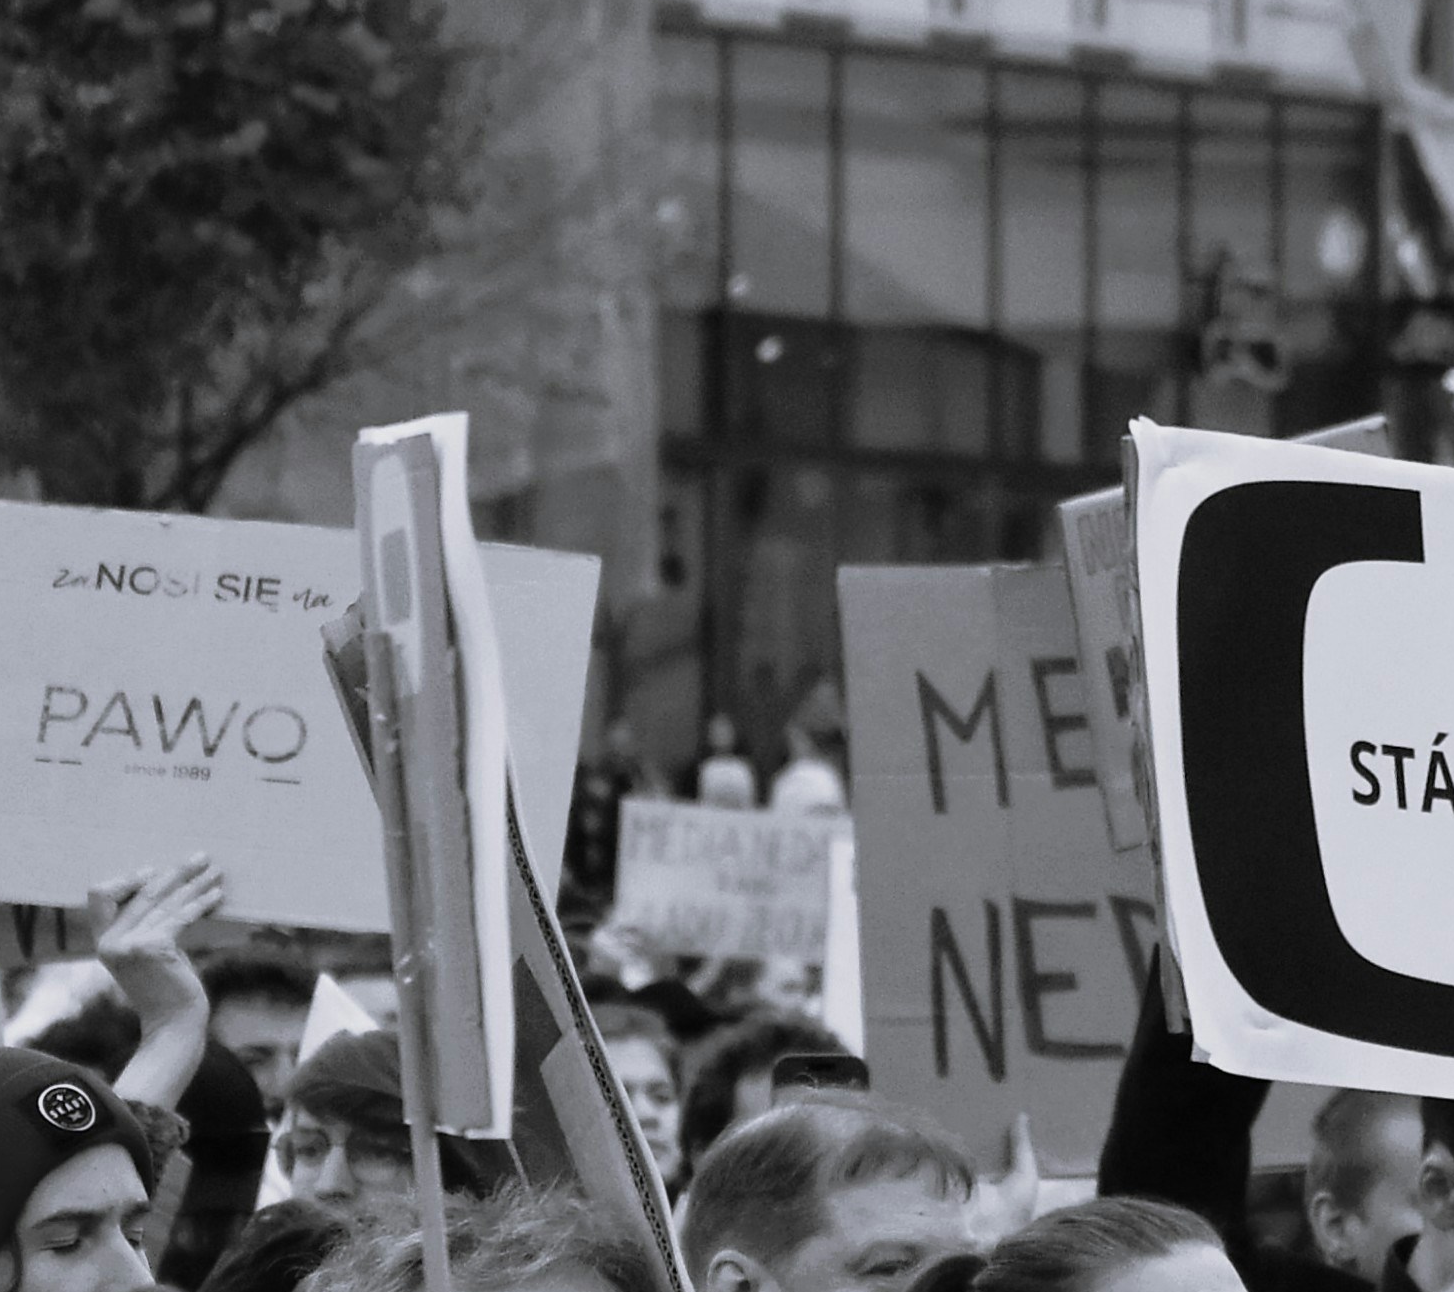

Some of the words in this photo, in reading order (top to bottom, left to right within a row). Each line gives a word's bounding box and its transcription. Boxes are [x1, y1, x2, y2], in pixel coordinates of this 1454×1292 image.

[36, 685, 307, 764] PAWO
[916, 657, 1097, 815] ME
[172, 765, 212, 782] 1989
